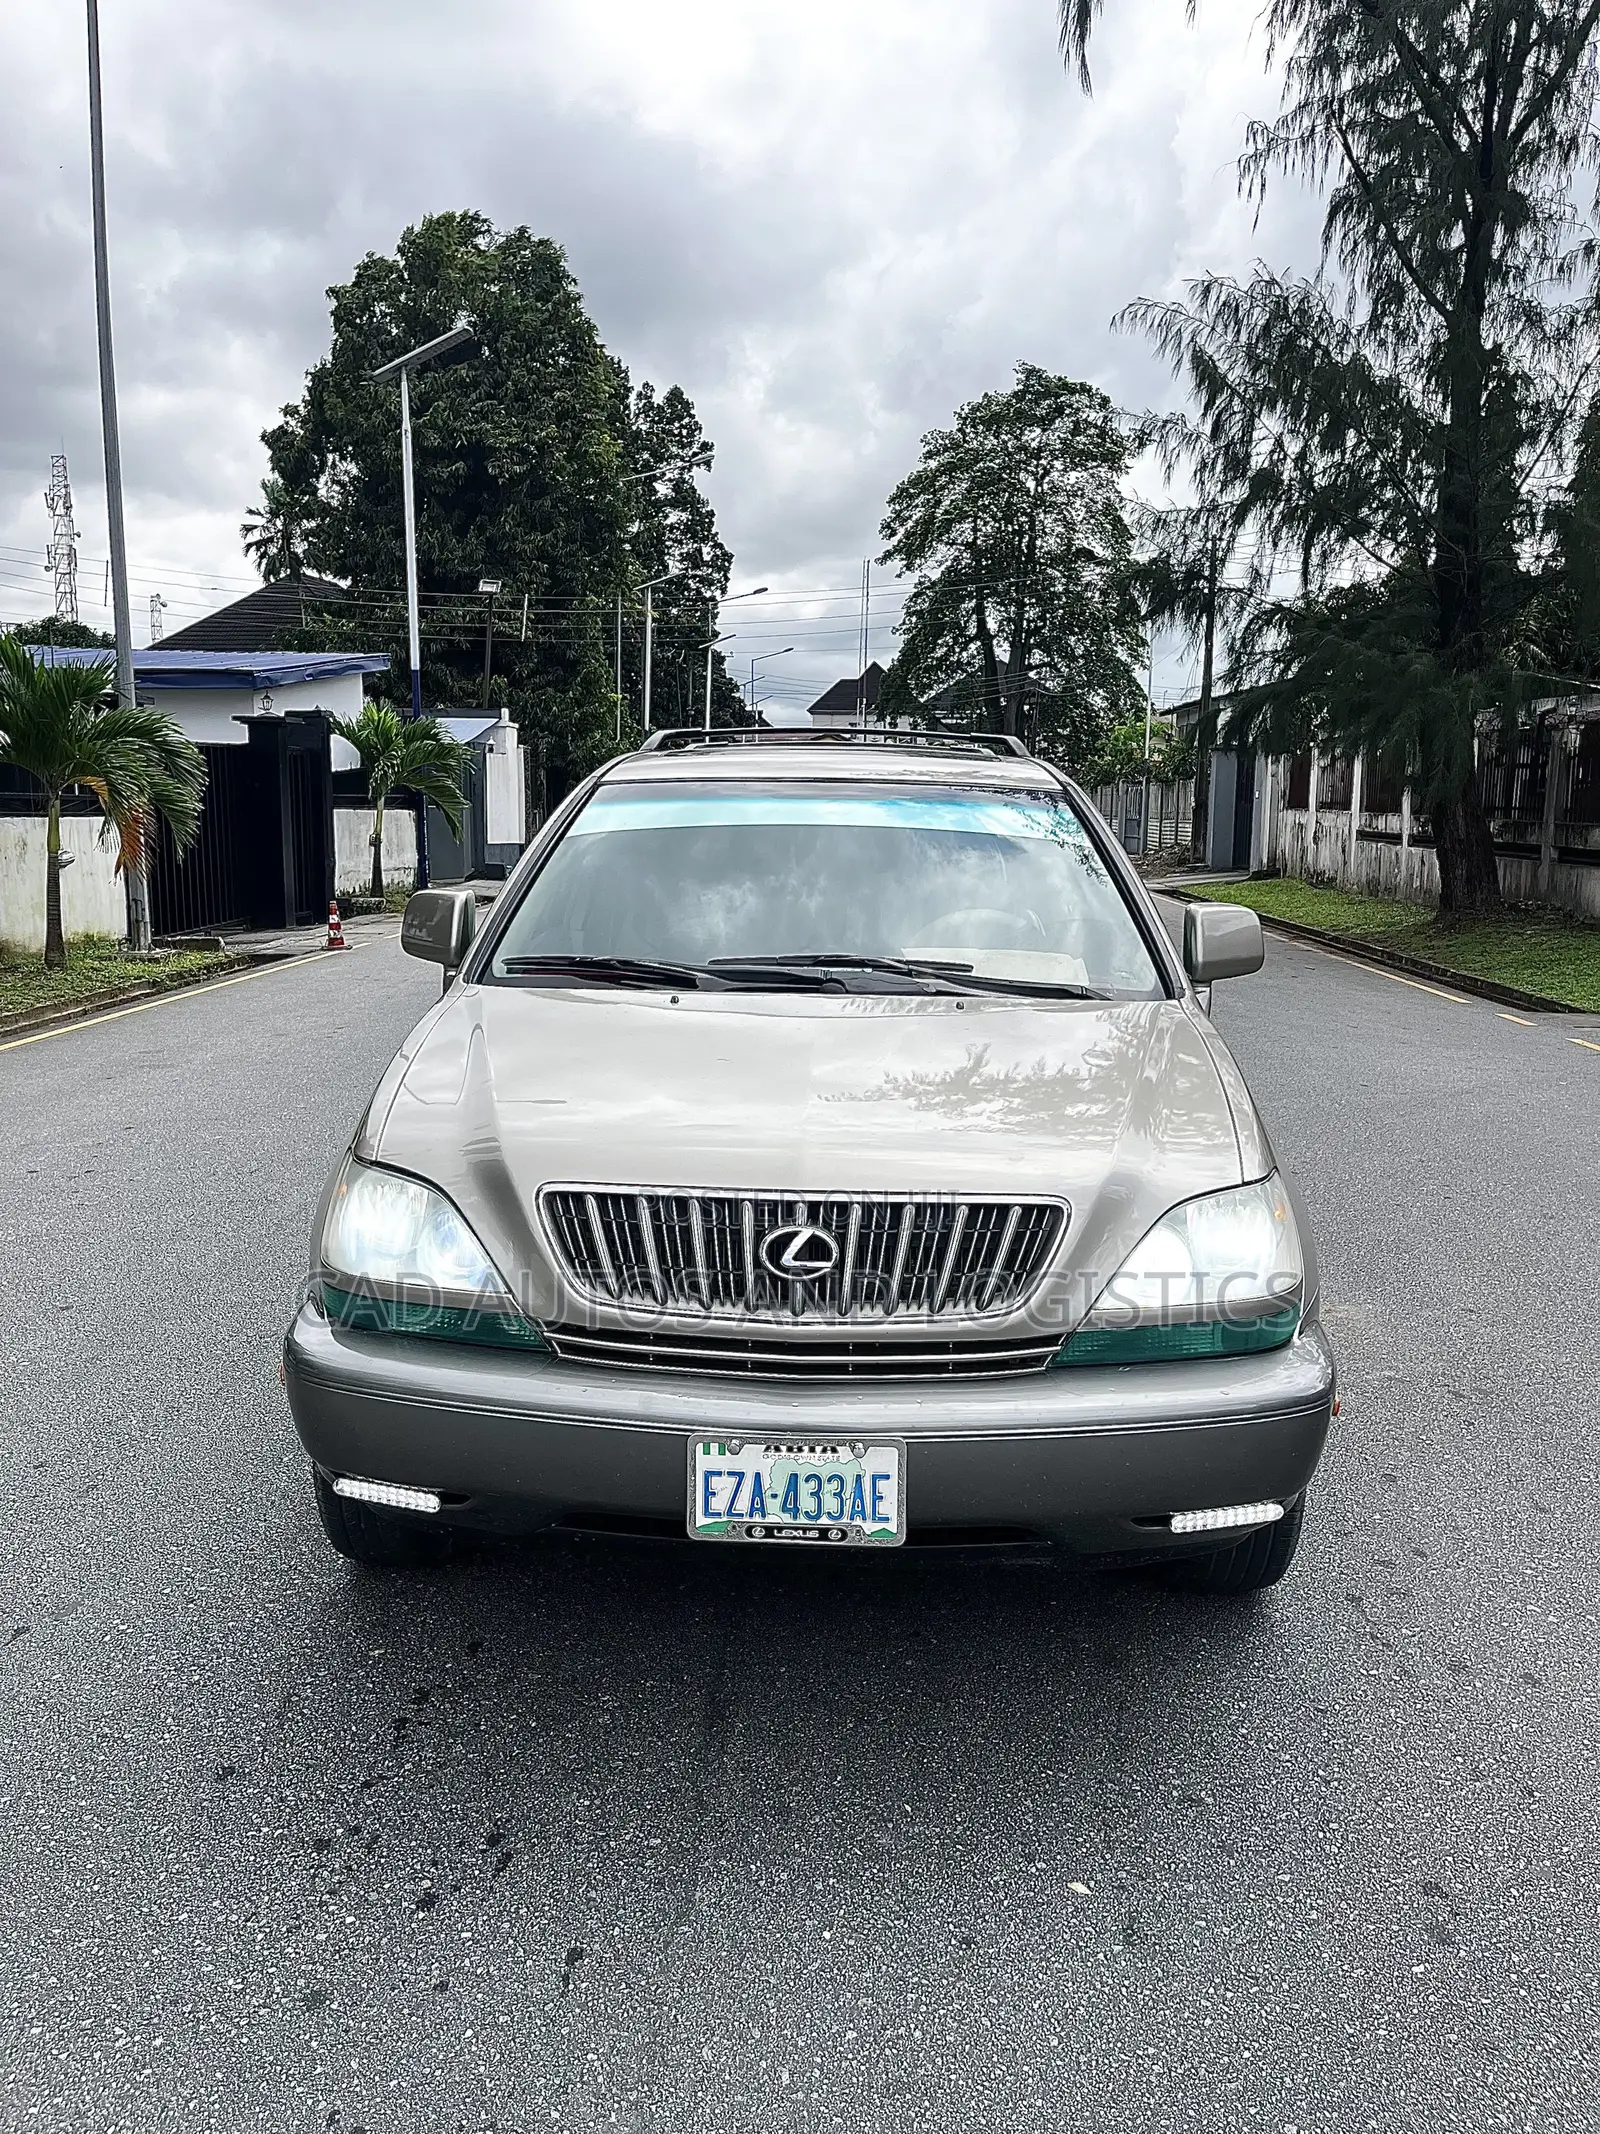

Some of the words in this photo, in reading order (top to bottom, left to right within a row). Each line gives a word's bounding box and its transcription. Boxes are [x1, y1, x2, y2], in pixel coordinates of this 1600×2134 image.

[763, 1444, 839, 1454] ABIA
[703, 1470, 891, 1522] EZA-433AE
[774, 1529, 820, 1538] LEXUS
